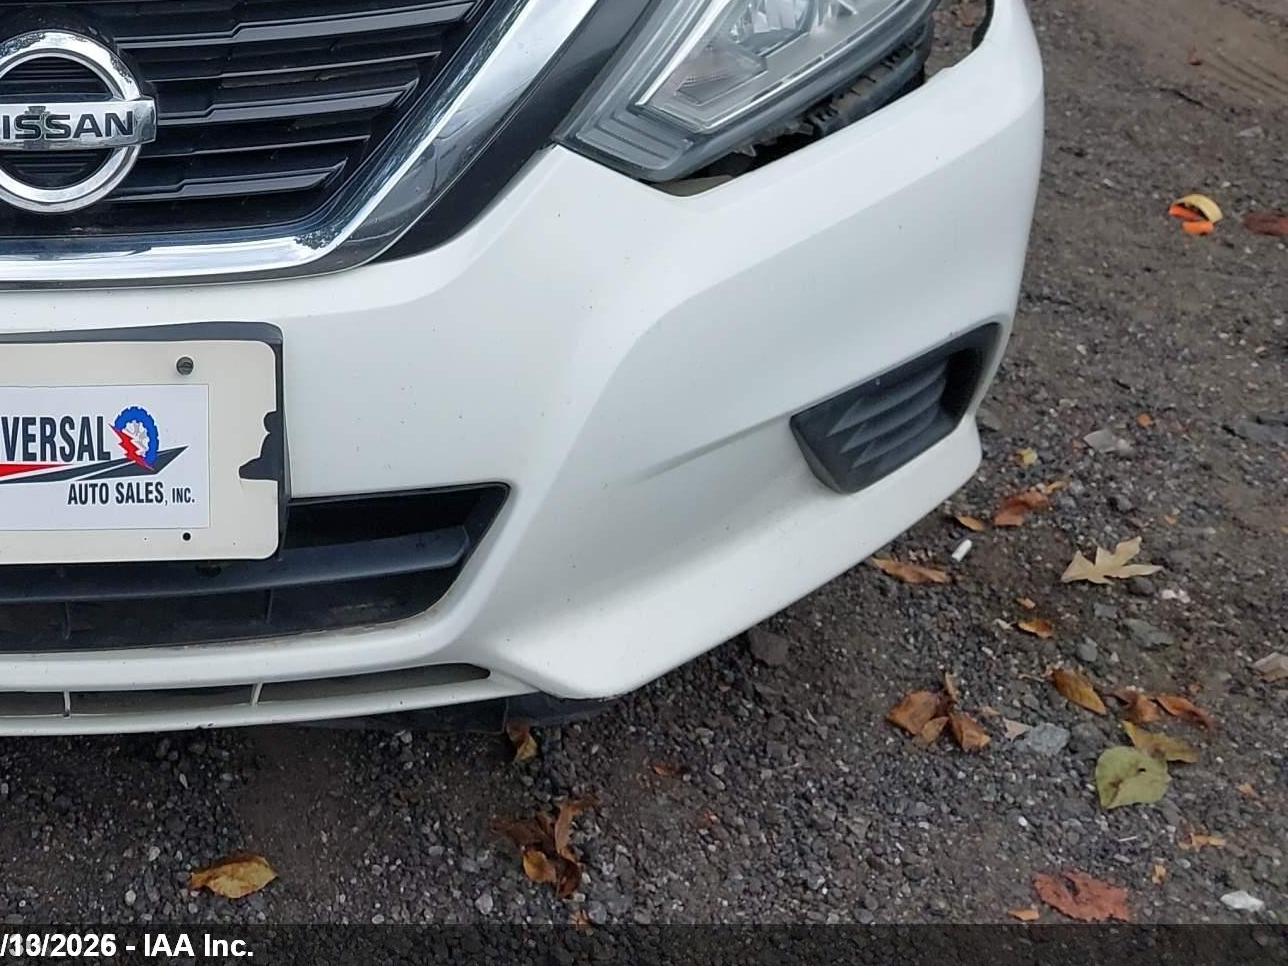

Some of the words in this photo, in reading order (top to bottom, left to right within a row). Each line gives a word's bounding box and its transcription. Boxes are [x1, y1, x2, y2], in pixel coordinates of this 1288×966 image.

[67, 483, 109, 505] AUTO
[115, 481, 168, 506] SALES,
[172, 487, 195, 504] INC.
